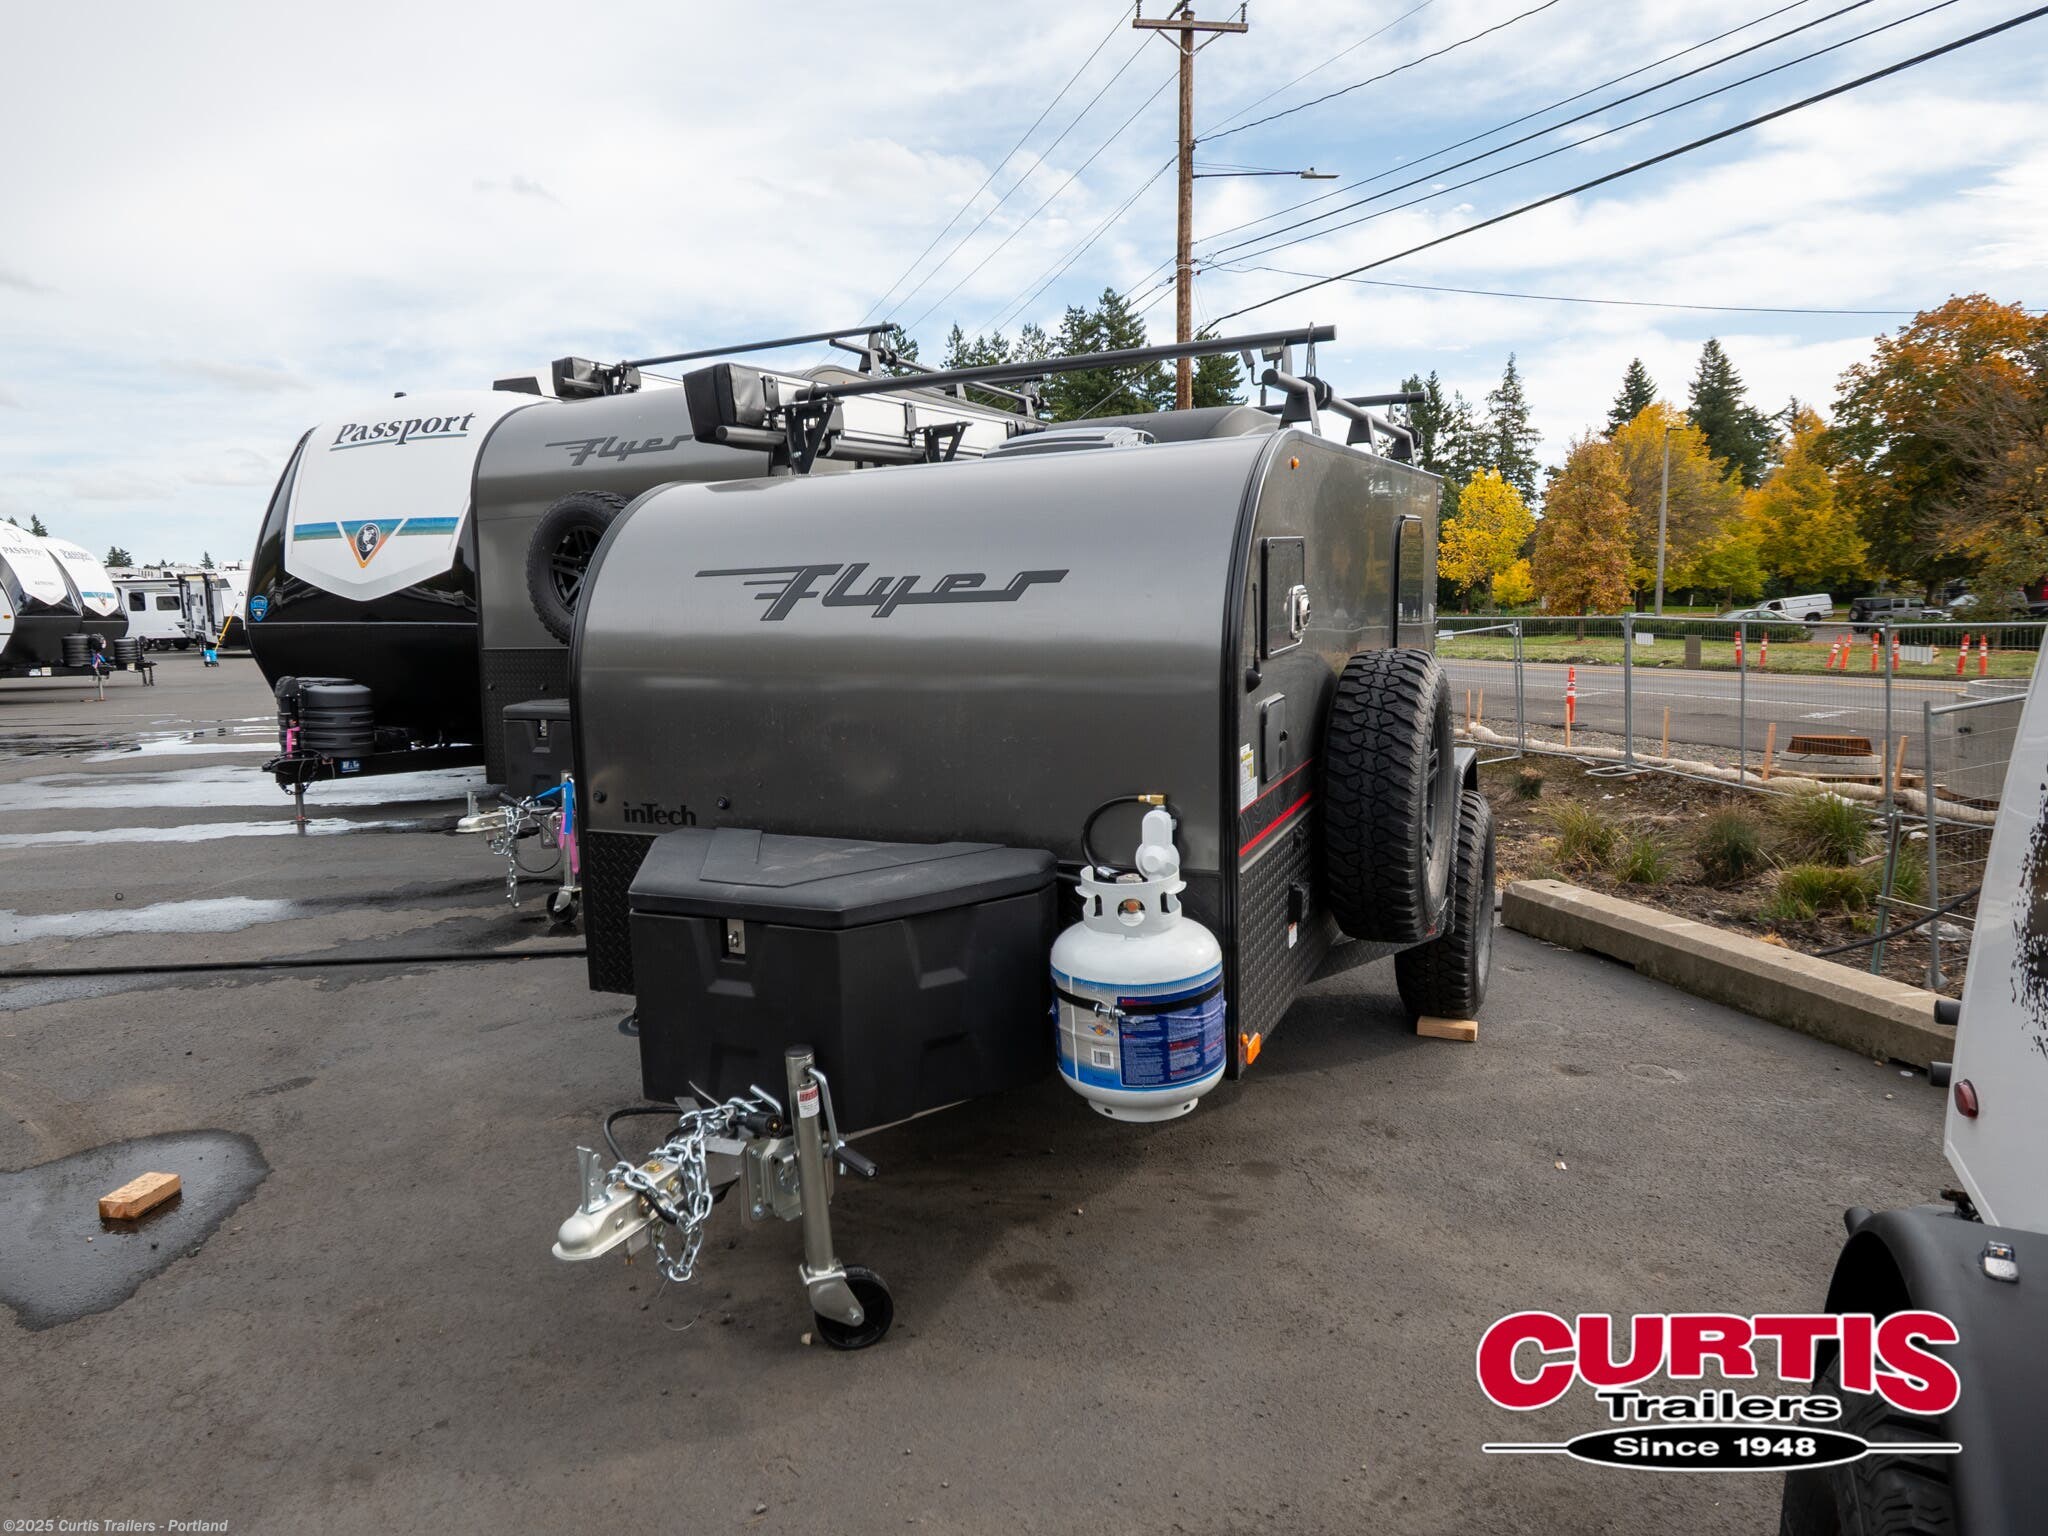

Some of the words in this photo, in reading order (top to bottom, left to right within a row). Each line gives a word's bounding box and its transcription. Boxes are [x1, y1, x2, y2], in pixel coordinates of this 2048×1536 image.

[333, 411, 476, 446] Passport
[545, 433, 695, 467] Flyer
[695, 562, 1070, 622] Flyer
[623, 801, 697, 826] inTech
